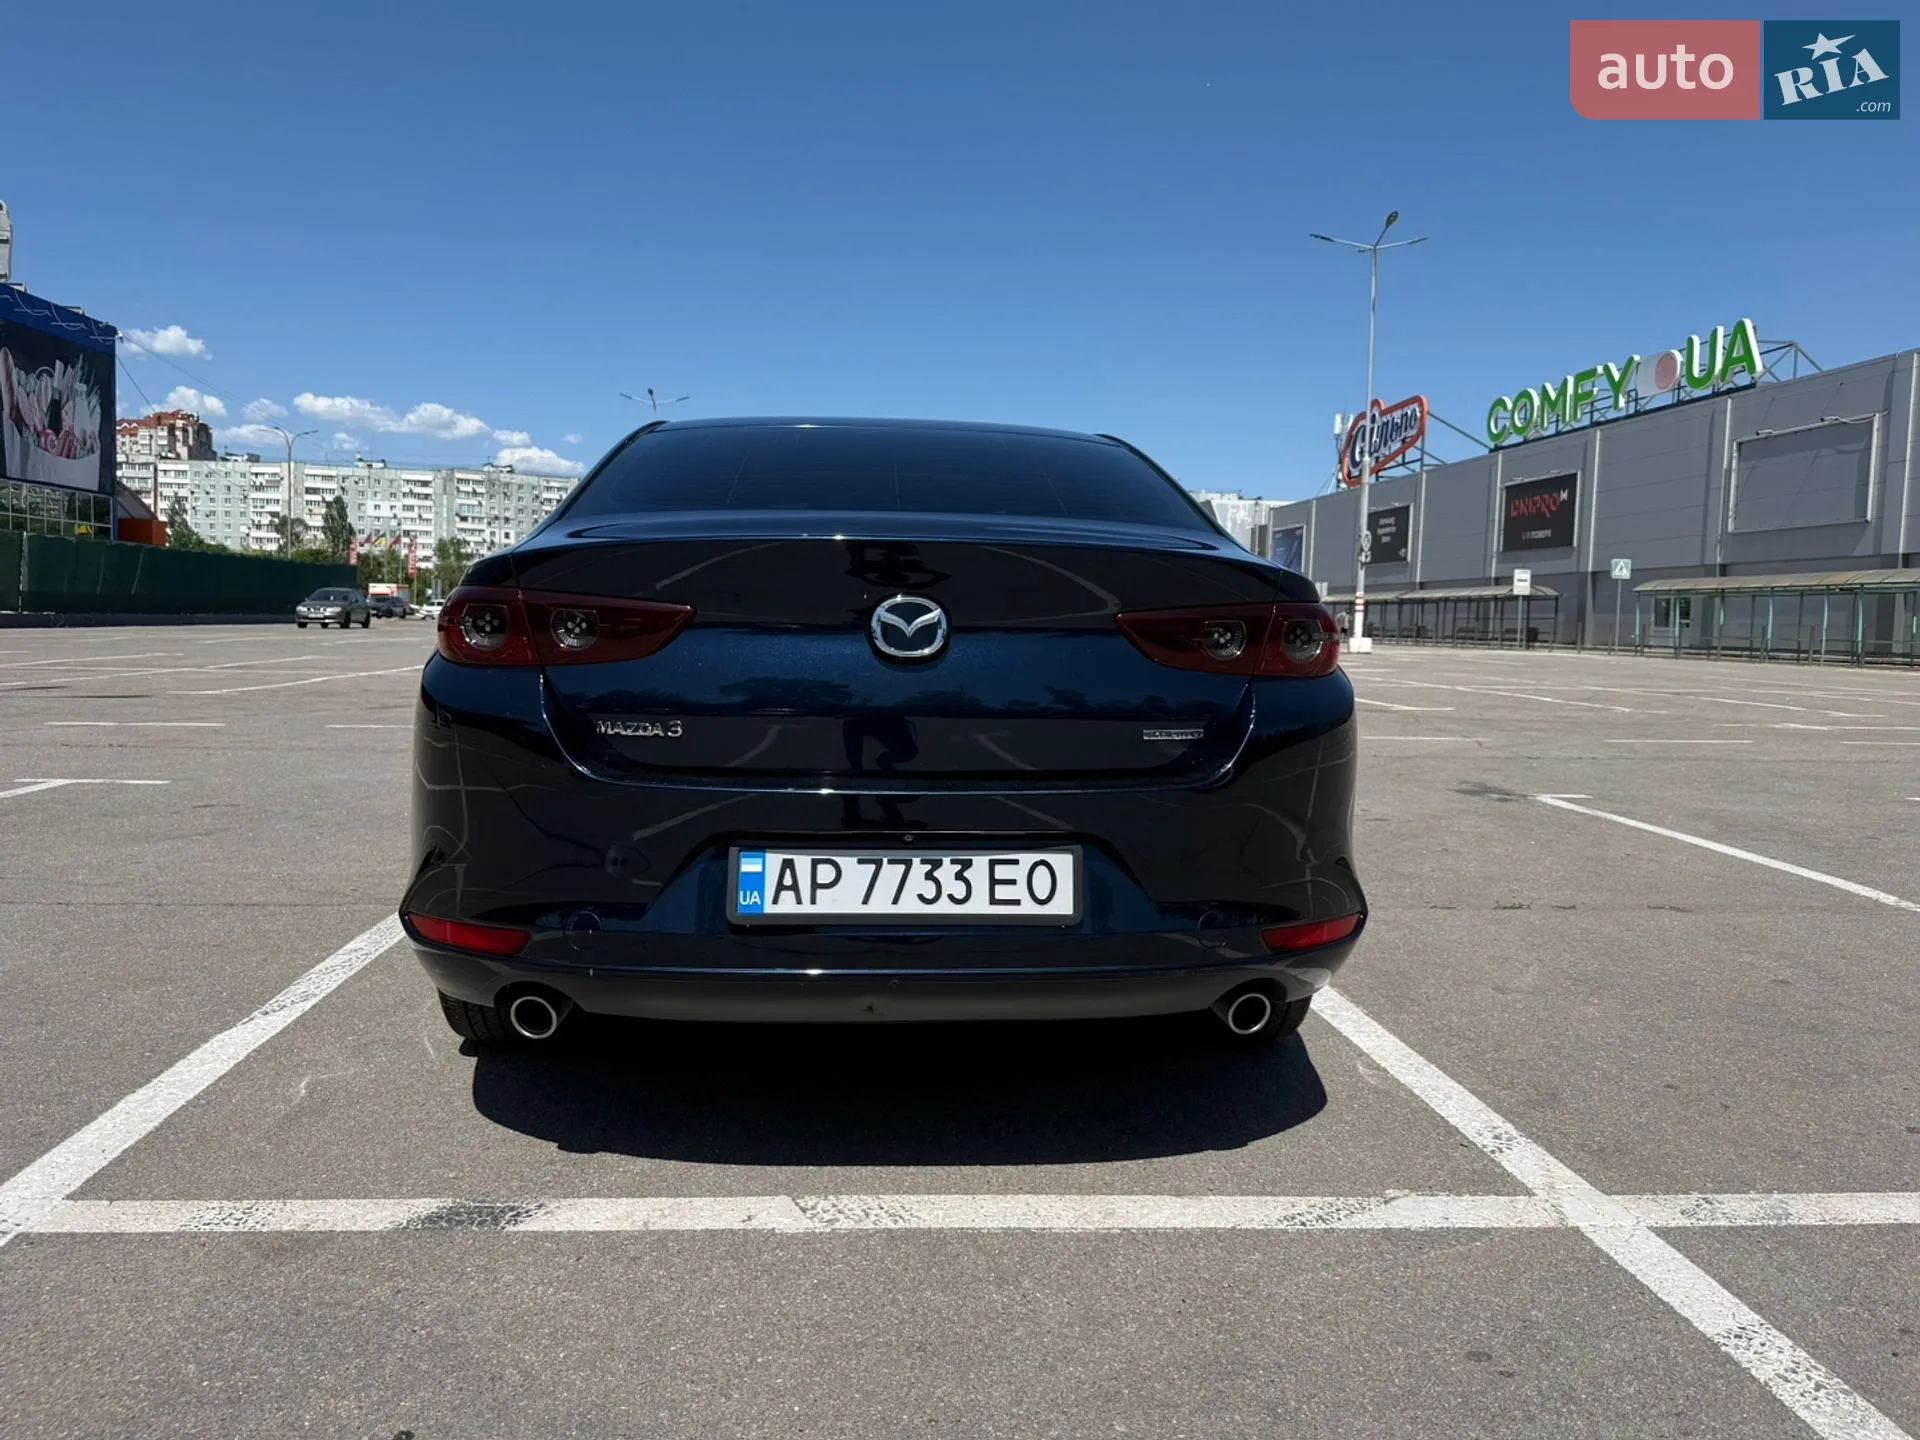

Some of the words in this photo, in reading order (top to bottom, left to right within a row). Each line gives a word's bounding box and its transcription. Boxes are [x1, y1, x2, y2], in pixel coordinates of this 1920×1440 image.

[1487, 354, 1641, 444] COMFY
[1685, 317, 1764, 391] UA
[596, 720, 665, 737] MAZDA
[667, 719, 683, 738] 3
[739, 890, 762, 905] UA
[771, 857, 843, 906] AP
[857, 857, 973, 906] 7733
